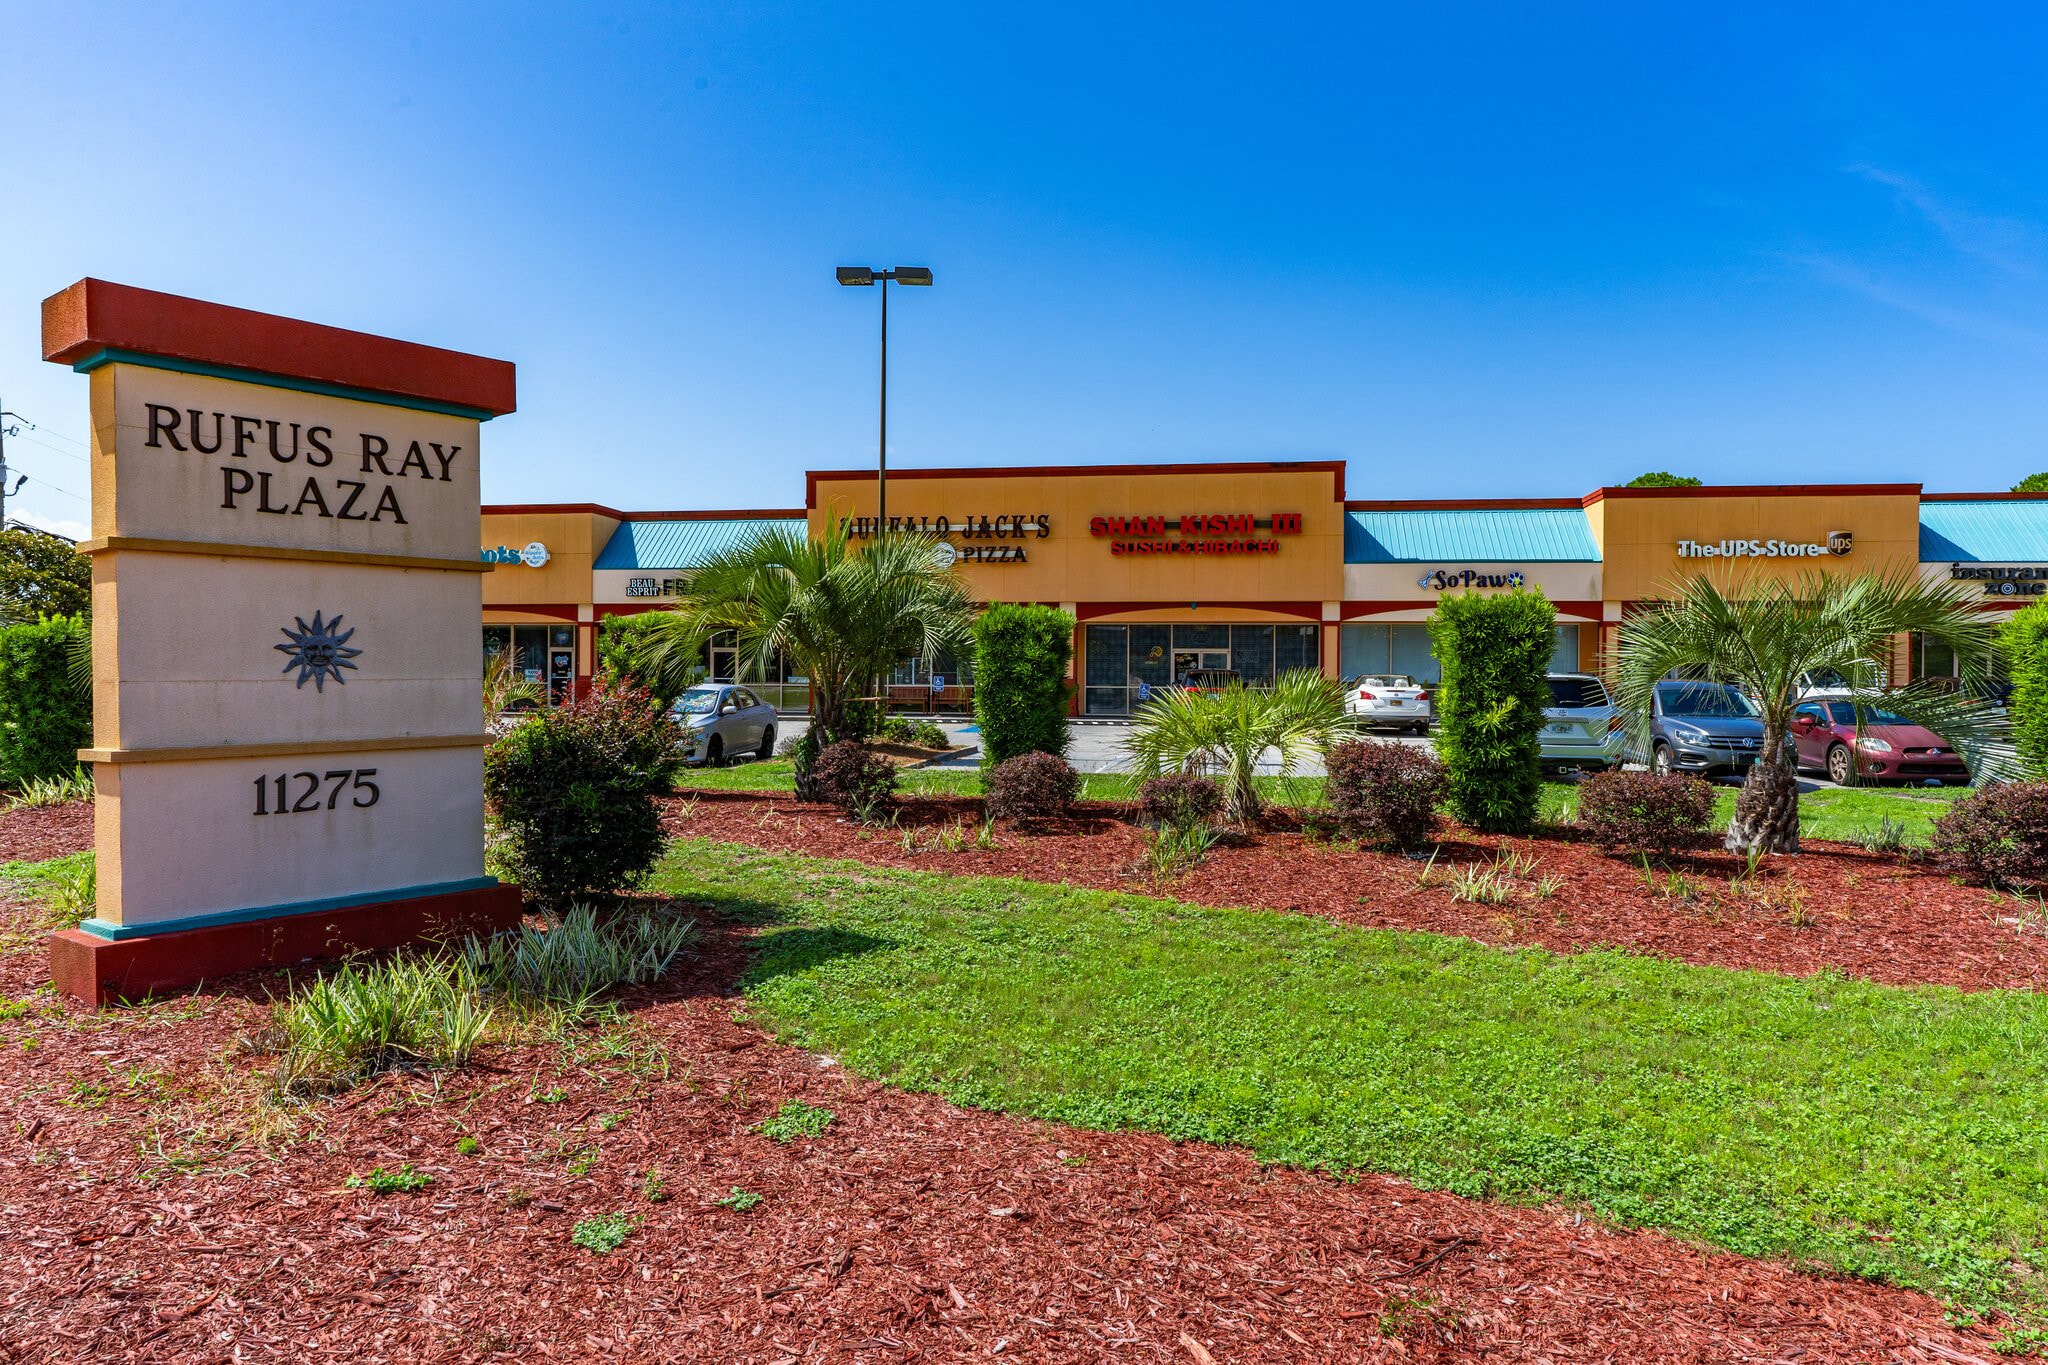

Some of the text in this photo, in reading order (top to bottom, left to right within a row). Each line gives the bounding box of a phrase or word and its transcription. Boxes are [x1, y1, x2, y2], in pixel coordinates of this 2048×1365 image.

[145, 403, 462, 481] RUFUS RAY
[220, 467, 408, 524] PLAZA
[962, 514, 1051, 539] JACK'S
[1090, 513, 1302, 537] SHAN KISHI III
[963, 546, 1028, 563] PIZZA
[1111, 540, 1173, 555] SUSHI
[1194, 538, 1279, 555] HIBACHI
[1678, 540, 1819, 557] The UPS Store
[1831, 537, 1852, 554] ups
[480, 545, 522, 565] ots
[631, 579, 655, 588] BEAU
[1434, 570, 1506, 590] SoPaw
[1984, 582, 2047, 596] zone
[626, 587, 659, 597] ESPRIT
[253, 768, 380, 816] 11275
